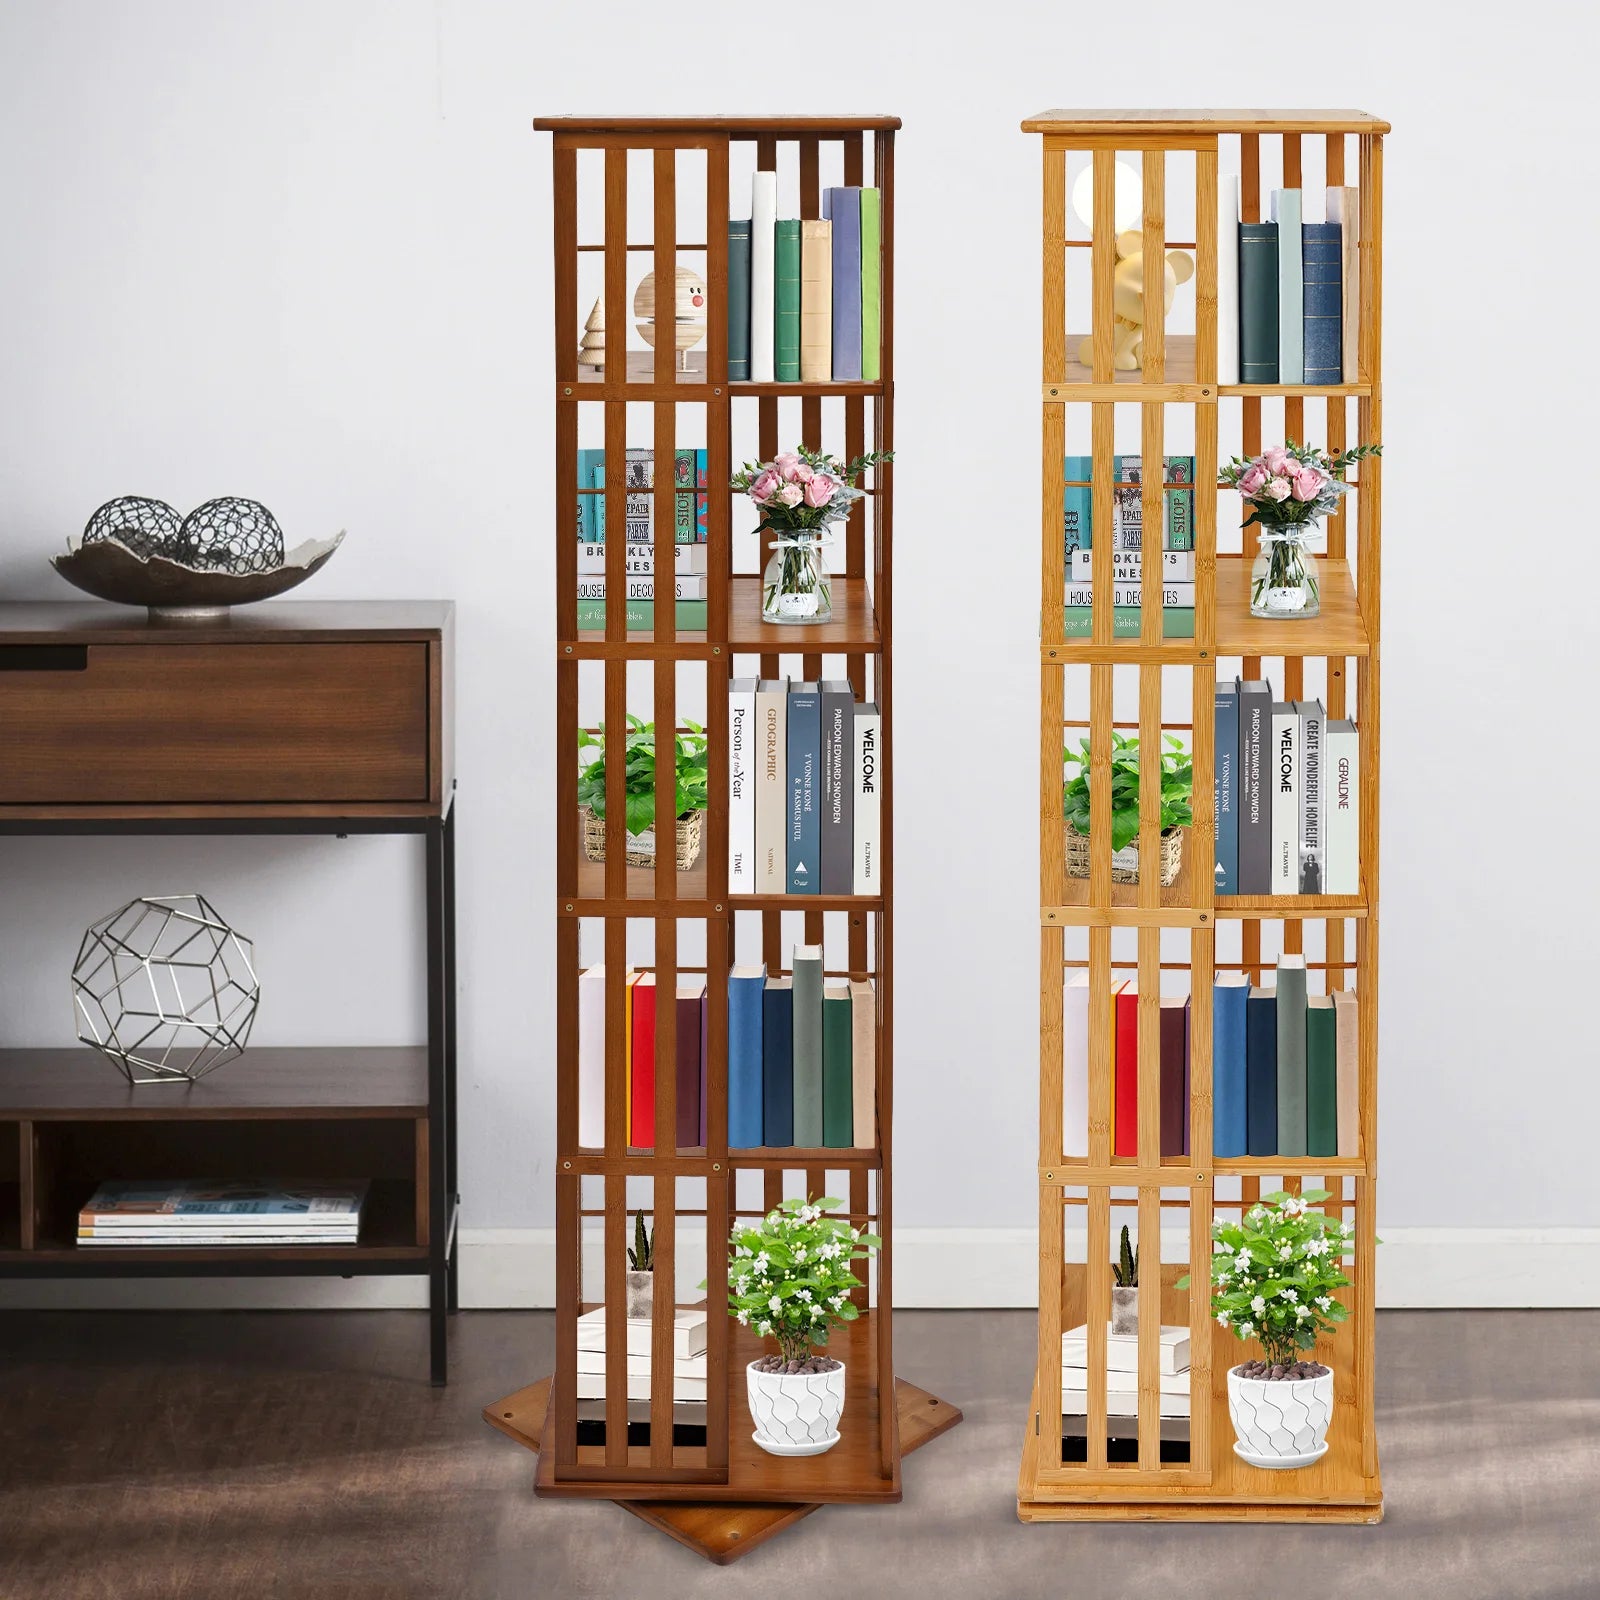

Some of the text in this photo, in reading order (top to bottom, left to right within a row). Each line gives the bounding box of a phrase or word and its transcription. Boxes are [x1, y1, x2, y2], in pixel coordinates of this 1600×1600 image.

[1065, 511, 1080, 566] BES
[1174, 498, 1185, 533] SHOP
[732, 708, 745, 799] Person of the Year
[833, 708, 842, 823] PARDON EDWARD SNOWDEN
[863, 728, 875, 794] WELCOME
[1251, 708, 1260, 823] PARDON EDWARD SNOWDEN
[1281, 728, 1292, 793] WELCOME
[1305, 719, 1319, 848] CREATE WONDERFUL HOMELIFE
[1338, 757, 1349, 809] GERALDINE
[793, 822, 802, 842] JUUL
[794, 789, 802, 821] RASMUS
[734, 853, 743, 875] TIME
